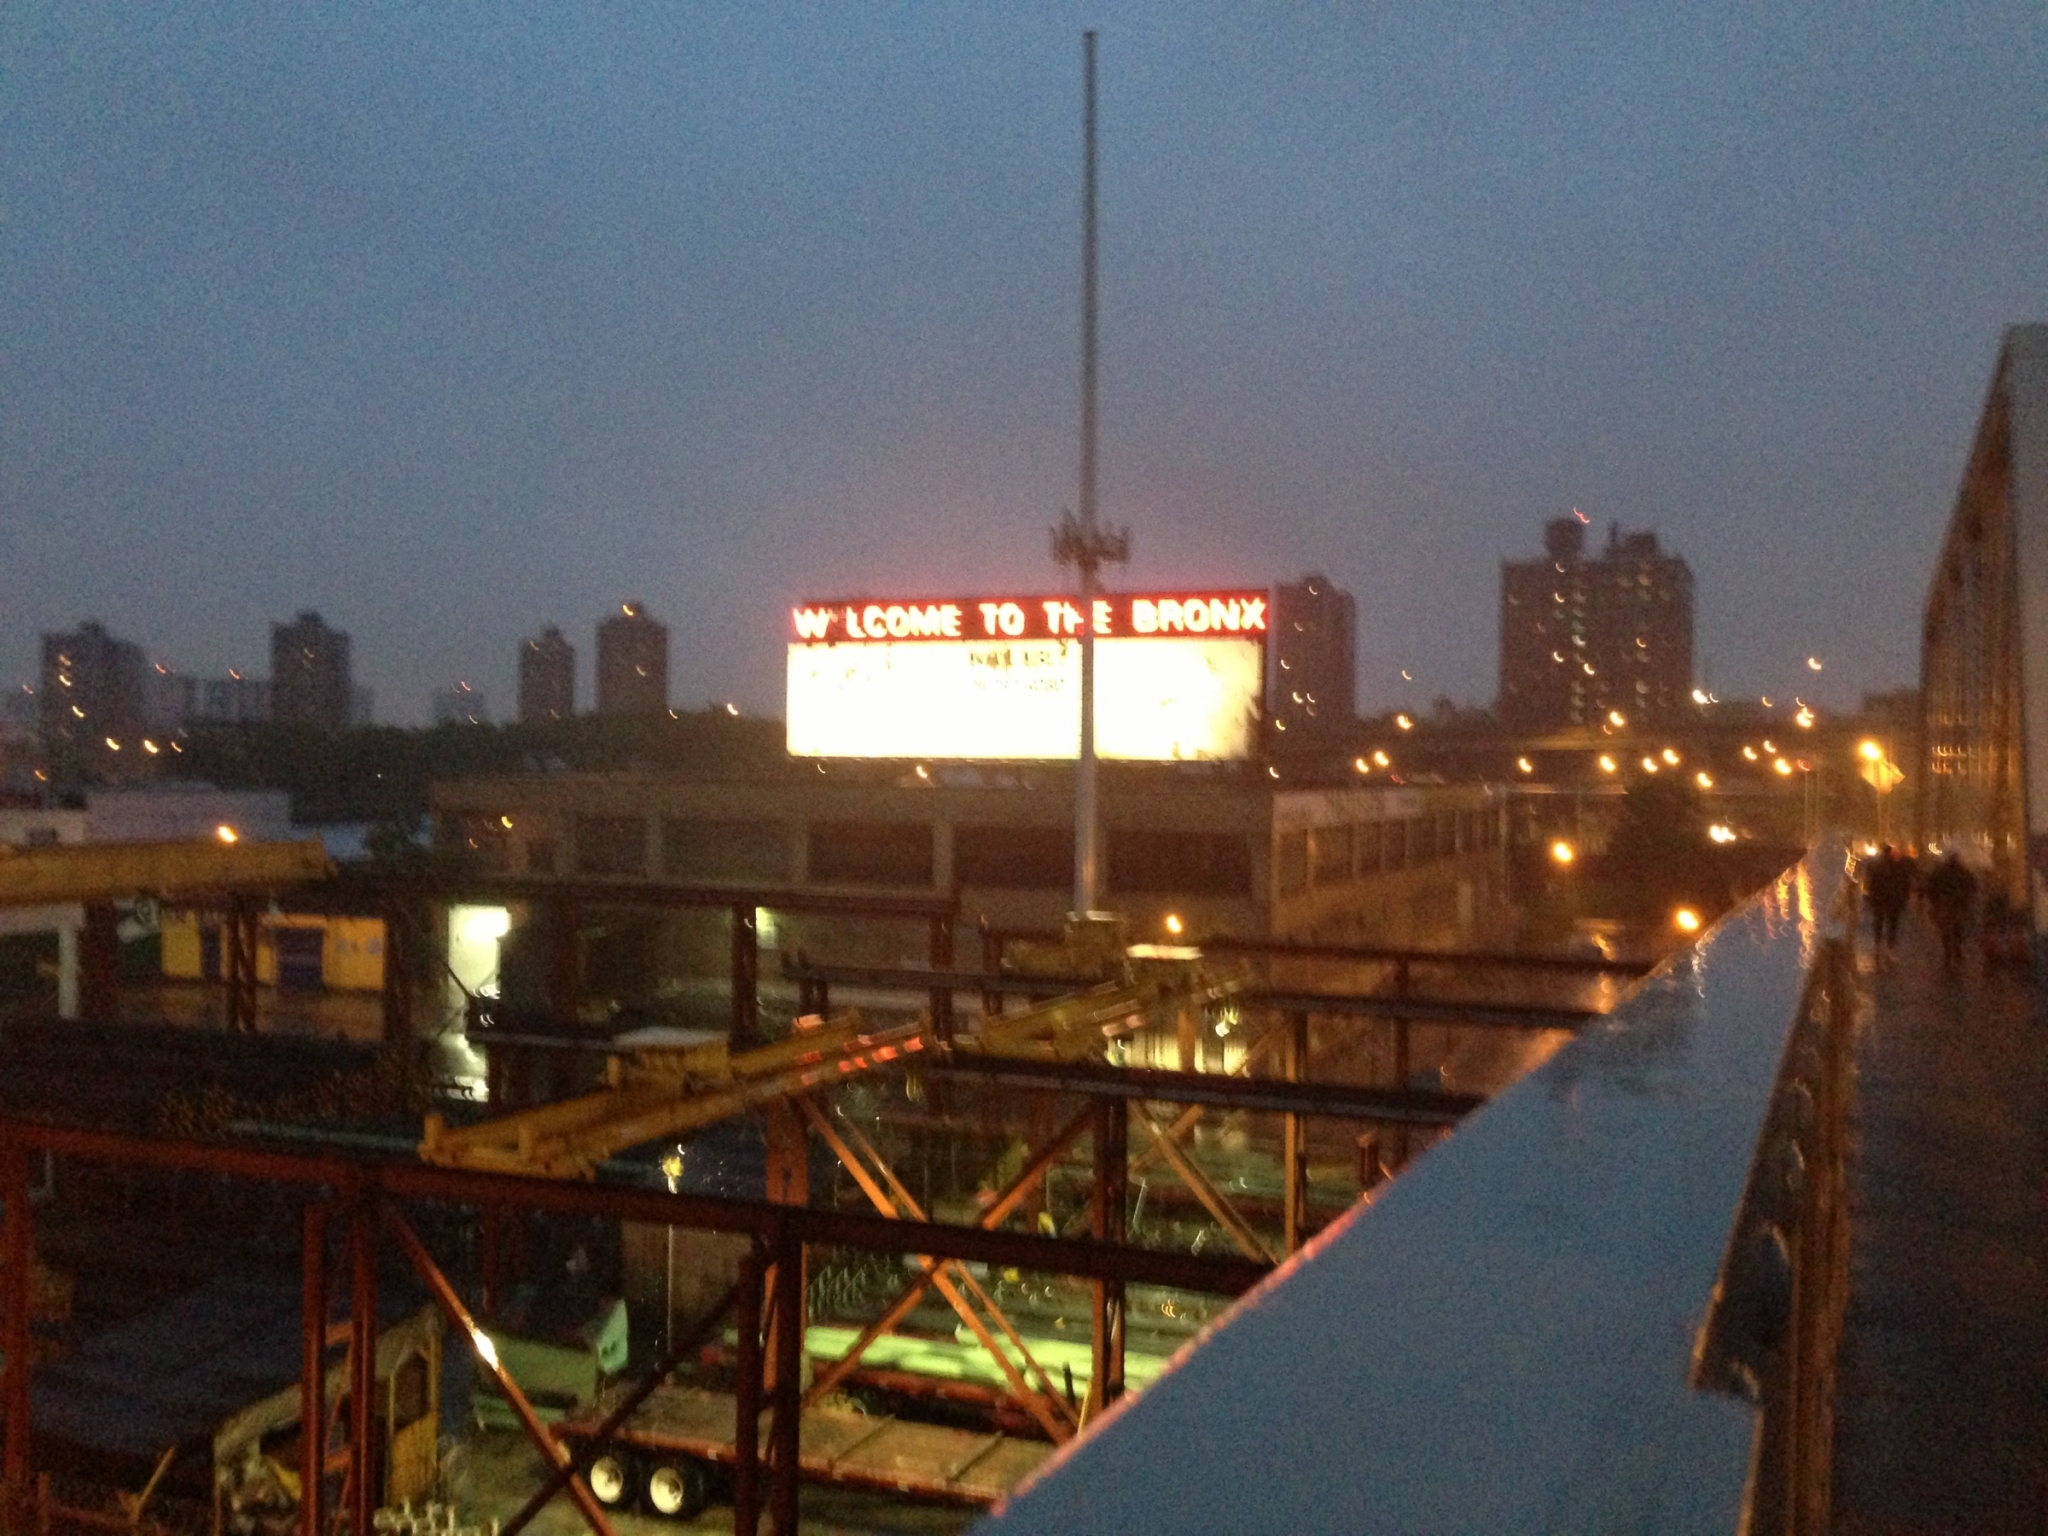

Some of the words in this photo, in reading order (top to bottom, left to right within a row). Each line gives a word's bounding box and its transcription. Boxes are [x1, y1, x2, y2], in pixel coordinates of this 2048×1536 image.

[792, 604, 963, 638] WLCOME
[978, 602, 1025, 636] TO
[1132, 597, 1267, 633] BRONX
